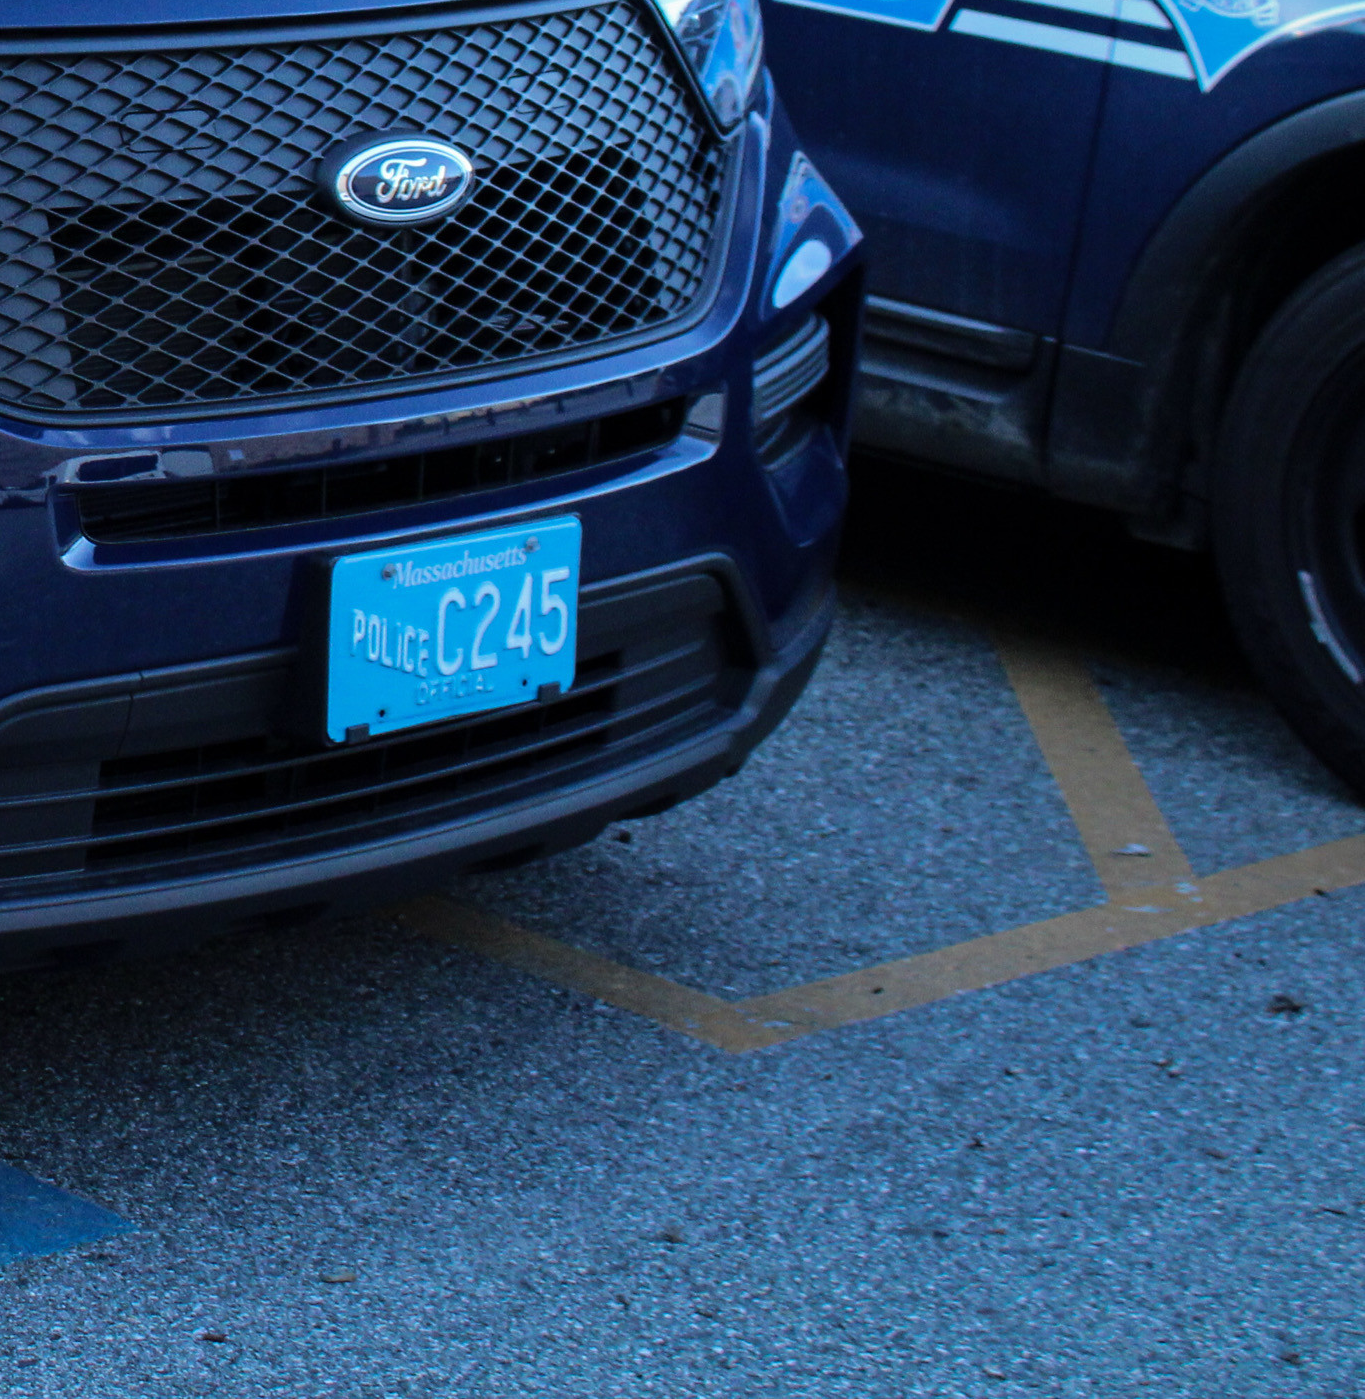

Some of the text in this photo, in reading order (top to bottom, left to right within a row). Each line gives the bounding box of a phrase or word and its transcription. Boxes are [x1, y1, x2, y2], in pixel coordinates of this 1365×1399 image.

[376, 157, 447, 203] Ford
[392, 547, 528, 589] Massachusetts
[351, 567, 570, 679] POLICE C245
